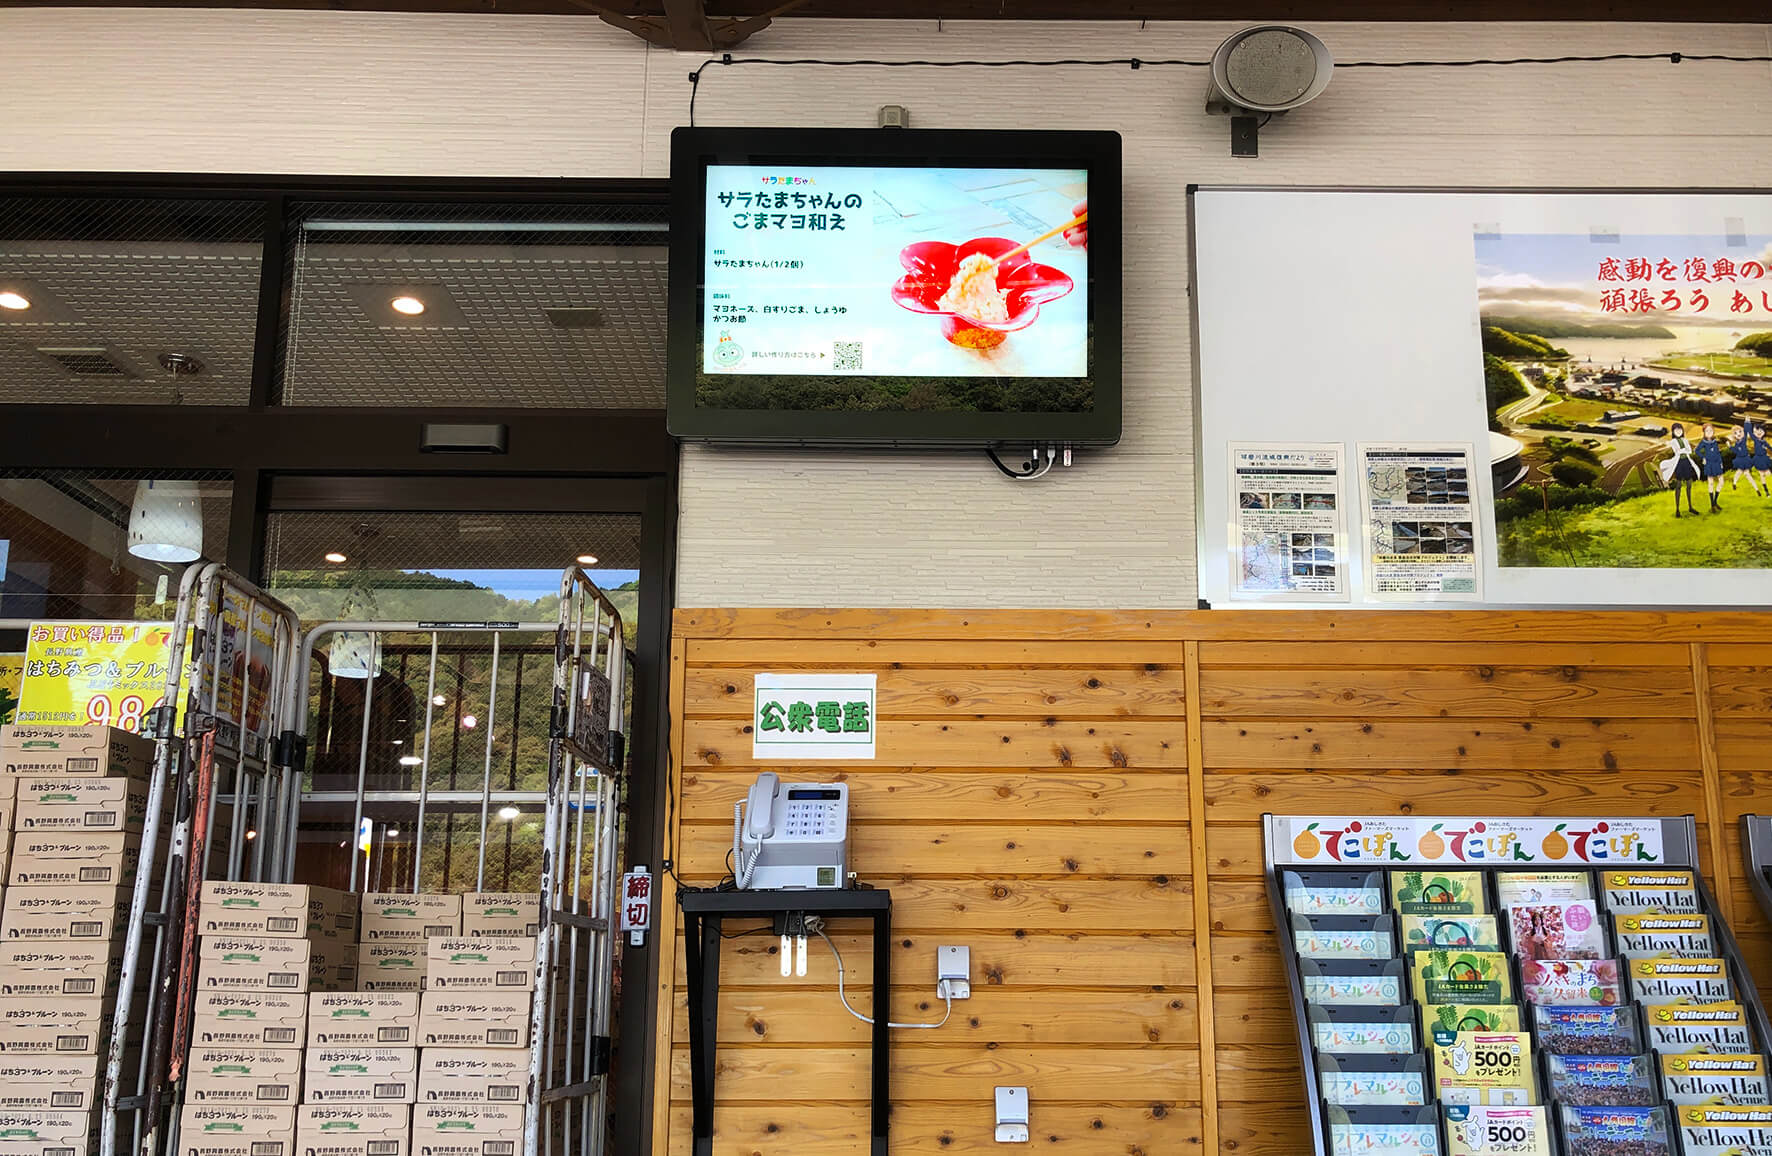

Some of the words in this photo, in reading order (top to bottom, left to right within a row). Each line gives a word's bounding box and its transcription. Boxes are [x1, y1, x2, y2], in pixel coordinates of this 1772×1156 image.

[718, 192, 862, 209] サラたまちゃんの
[733, 212, 845, 230] ごまマヨ和え
[1598, 256, 1772, 283] 感動を復興の
[1600, 288, 1710, 313] 頑張ろう
[32, 626, 140, 643] お買い得品！
[760, 701, 869, 732] 公衆電話
[1320, 821, 1411, 861] でこぽん
[1444, 822, 1535, 862] でこぽん
[1567, 822, 1658, 862] でこぽん
[627, 876, 649, 926] 締切
[1611, 892, 1663, 906] Yellow
[1665, 892, 1694, 906] Hat
[1623, 935, 1676, 951] Yellow
[1678, 935, 1709, 951] Hat
[1552, 987, 1588, 1001] 久留米
[1637, 980, 1694, 996] Yellow
[1696, 980, 1726, 996] Hat
[1655, 1028, 1712, 1044] Yellow
[1714, 1028, 1745, 1044] Hat
[1669, 1077, 1728, 1095] Yellow
[1731, 1077, 1764, 1095] Hat
[1687, 1129, 1747, 1146] Yellow
